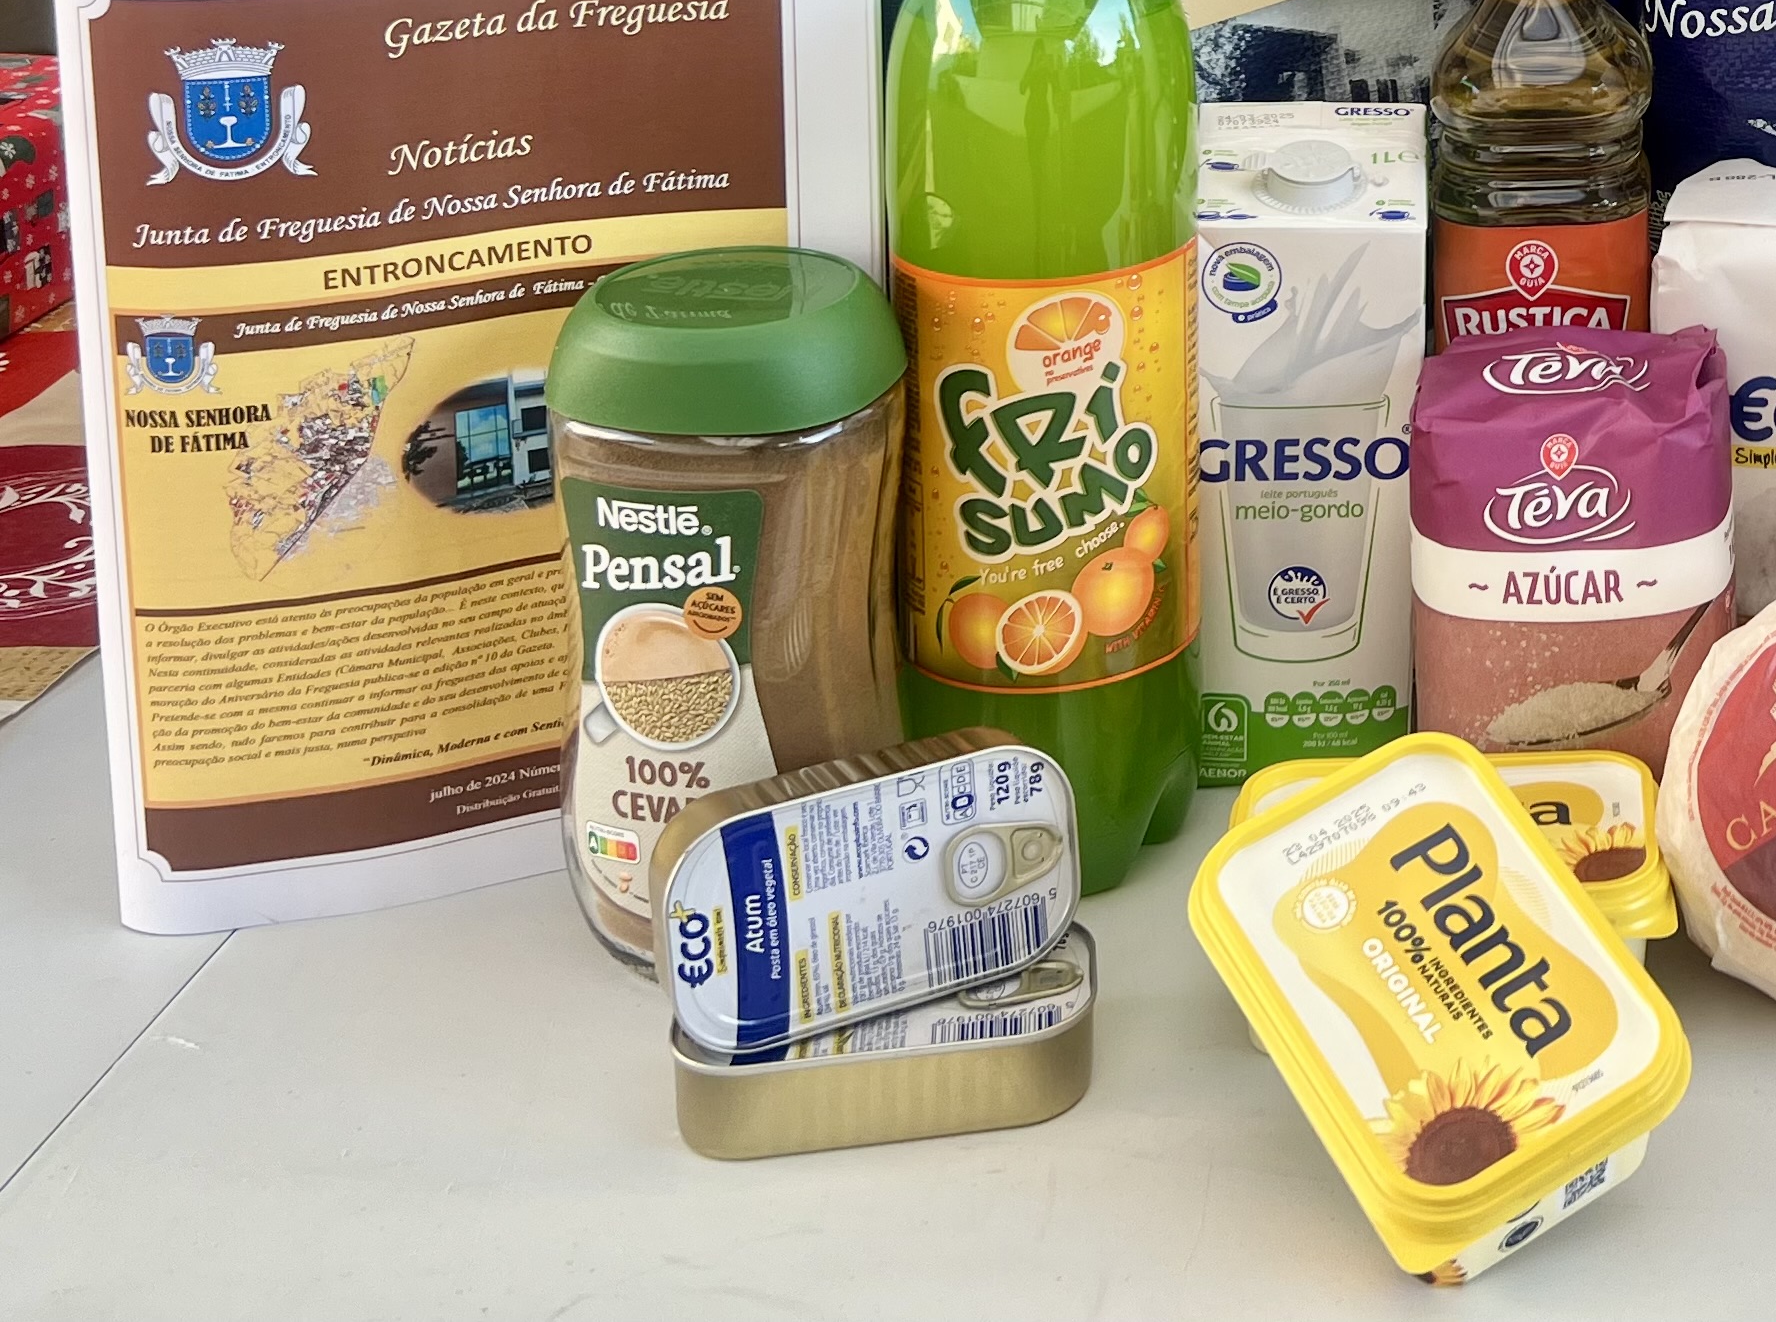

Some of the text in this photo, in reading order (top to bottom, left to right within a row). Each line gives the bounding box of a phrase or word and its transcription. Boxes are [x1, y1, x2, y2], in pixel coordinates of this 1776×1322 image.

[384, 12, 506, 59] Gazeta
[1335, 107, 1410, 117] GRESSO
[388, 130, 533, 176] Notícias
[133, 168, 730, 249] Junta de Freguesia de Nossa Senhora de Fátima
[324, 233, 594, 290] ENTRONCAMENTO
[1514, 243, 1549, 262] MARCA
[1455, 307, 1611, 335] RUSTICA
[1042, 338, 1102, 368] orange
[125, 403, 272, 428] NOSSA SENHORA
[151, 430, 249, 454] DE FÁTIMA
[1200, 437, 1410, 482] GRESSO
[596, 496, 699, 536] Nestlé
[1236, 500, 1364, 522] meio-gordo
[1261, 488, 1338, 499] leite português
[1496, 482, 1609, 529] Téva
[581, 536, 735, 591] Pensal
[979, 519, 1124, 587] You're free choose.
[1503, 566, 1623, 605] AZÚCAR
[429, 771, 516, 803] julho de 2024
[625, 756, 710, 789] 100%
[996, 761, 1011, 804] 120g
[1029, 760, 1045, 796] 78g
[745, 894, 764, 954] Atum
[762, 858, 781, 980] Posta em óleo vegetal
[927, 887, 1057, 932] 5 607274 001976
[1378, 900, 1432, 964] 100%
[1390, 823, 1572, 1059] Planta
[1361, 937, 1443, 1044] ORIGINAL
[1417, 964, 1463, 1021] NATURAIS
[1428, 958, 1494, 1040] INGREDIENTES
